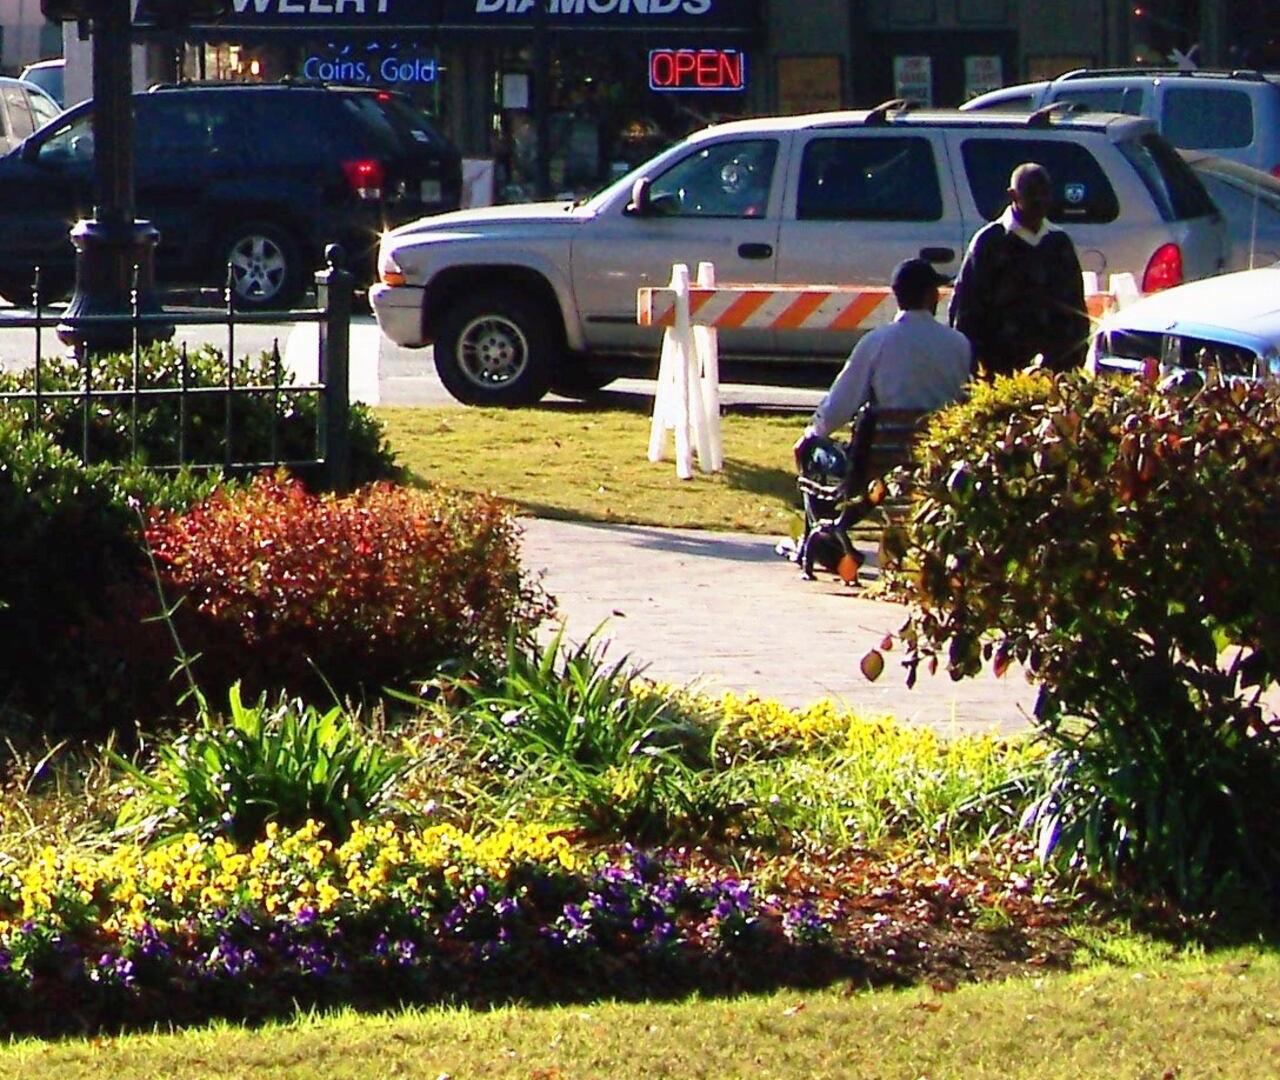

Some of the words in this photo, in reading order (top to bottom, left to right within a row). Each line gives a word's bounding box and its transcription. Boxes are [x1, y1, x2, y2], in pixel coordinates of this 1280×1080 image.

[303, 56, 372, 83] Coins,
[380, 56, 436, 82] Gold
[651, 52, 741, 88] OPEN
